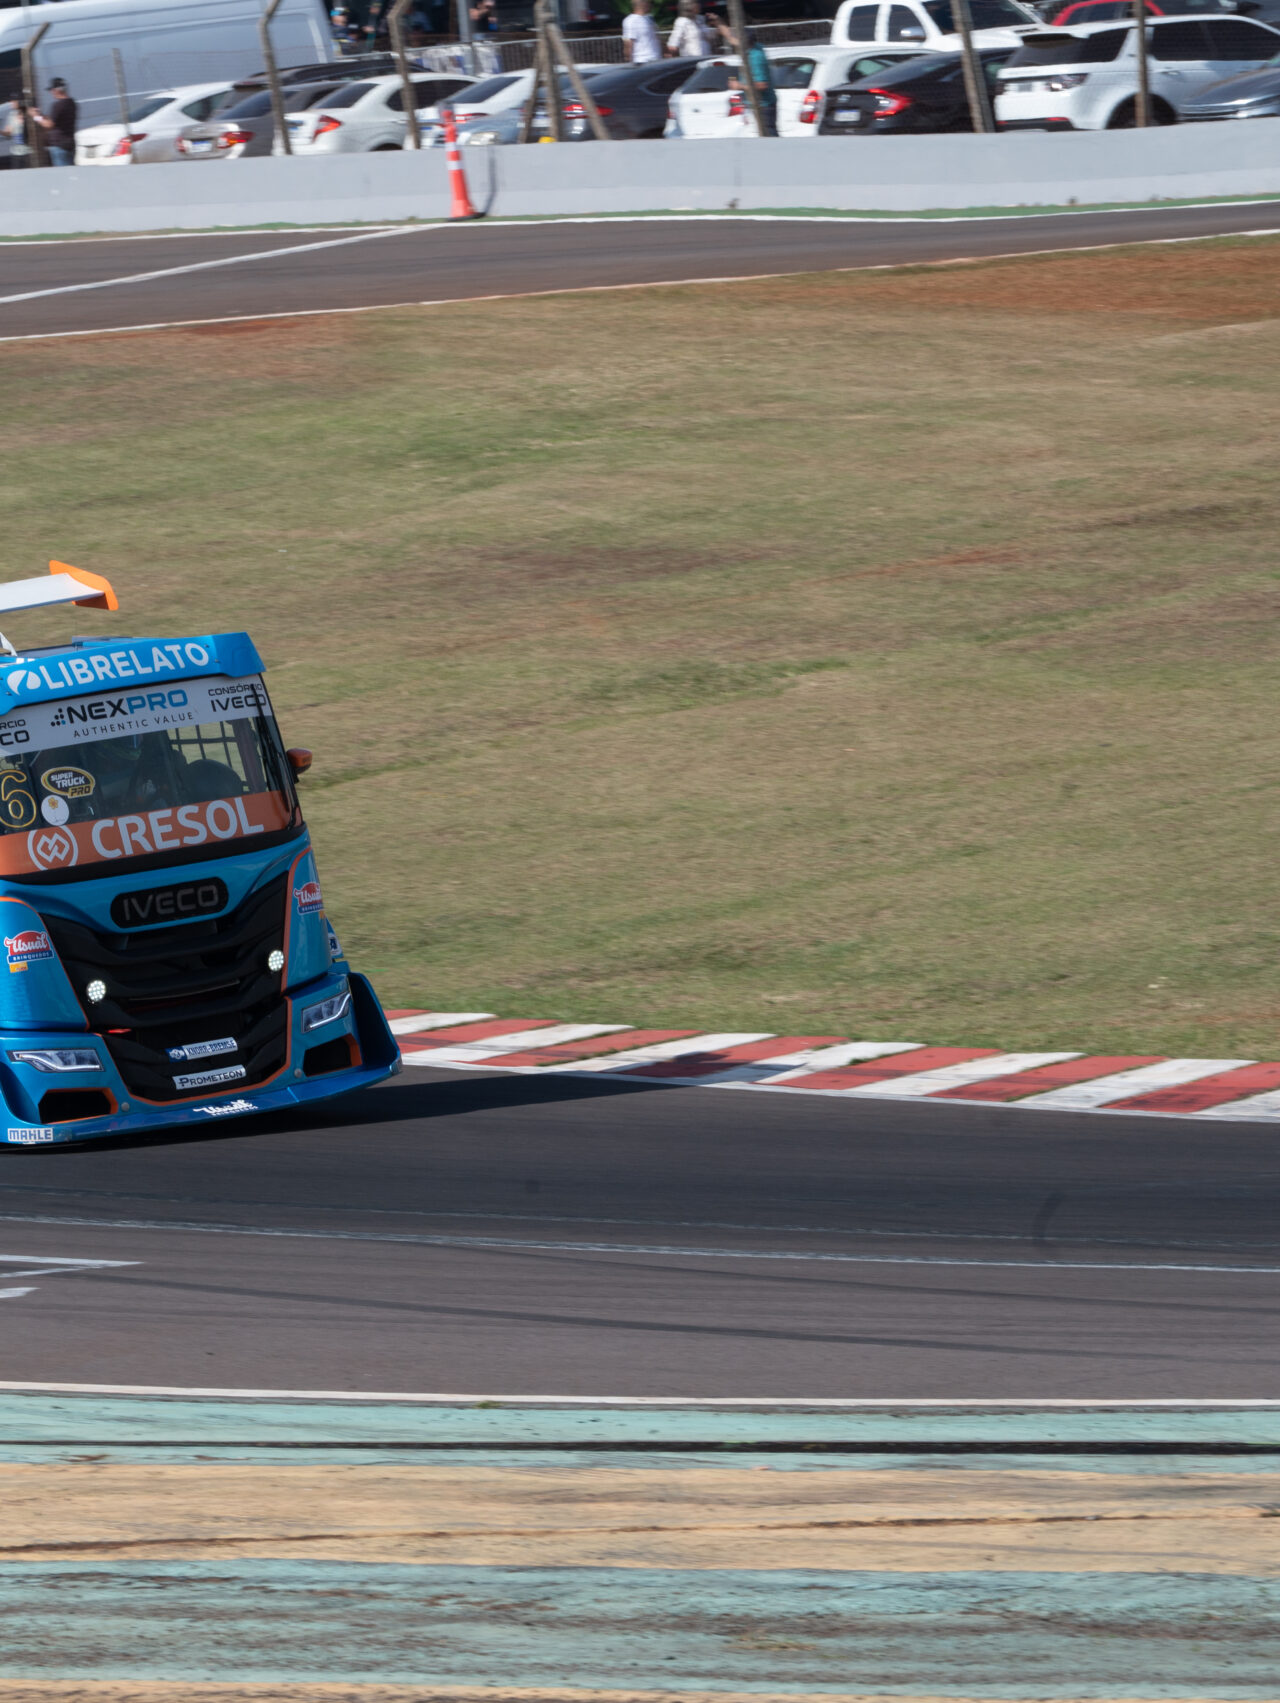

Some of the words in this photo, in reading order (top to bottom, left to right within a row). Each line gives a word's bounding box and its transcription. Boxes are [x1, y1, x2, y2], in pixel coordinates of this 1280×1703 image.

[39, 643, 209, 690] LIBRELATO
[66, 689, 189, 724] NEXPRO
[211, 694, 267, 713] IVECO
[73, 718, 149, 738] AUTHENTIC
[154, 711, 194, 725] VALUE
[51, 771, 74, 782] SUPER
[55, 776, 86, 789] TRUCK
[70, 785, 92, 797] PRO
[91, 797, 265, 858] CRESOL
[123, 884, 219, 921] IVECO
[6, 933, 48, 953] Usual
[186, 1039, 237, 1056] KNORR-BREMSE
[179, 1069, 243, 1087] PROMETEON
[9, 1129, 52, 1140] MAHLE
